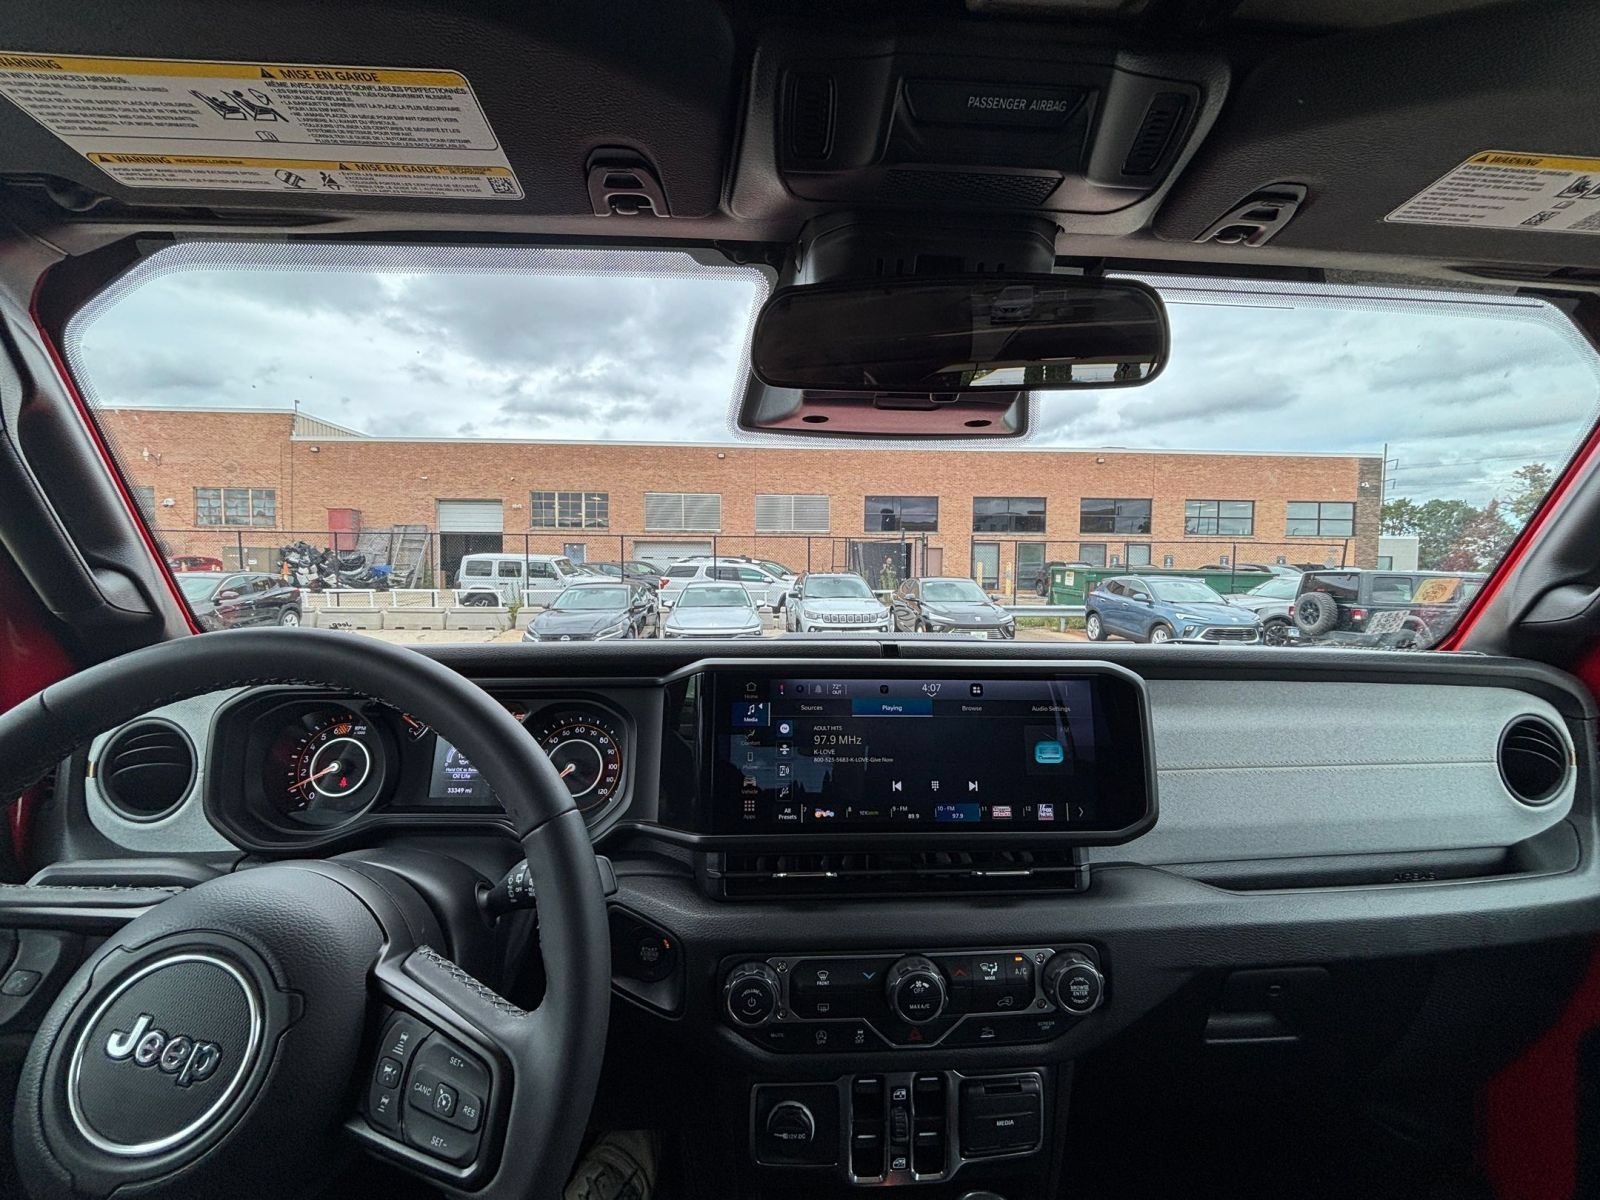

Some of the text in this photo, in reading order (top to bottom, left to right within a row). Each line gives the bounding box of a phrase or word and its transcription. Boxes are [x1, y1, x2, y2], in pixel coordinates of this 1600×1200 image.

[280, 70, 379, 82] MISE EN GARDE
[967, 96, 1067, 112] PASSENGER AIRBAG
[112, 155, 172, 164] WARNING
[355, 163, 383, 171] MISE
[385, 165, 400, 173] EN
[401, 165, 439, 174] GARDE
[922, 684, 941, 692] 4:07
[347, 725, 352, 733] 7
[813, 735, 862, 745] 97.9 MHz
[1015, 967, 1028, 976] A/C
[106, 1013, 221, 1087] Jeep
[414, 1082, 432, 1096] CANC
[462, 1105, 475, 1118] RES
[997, 1119, 1014, 1127] MEDIA
